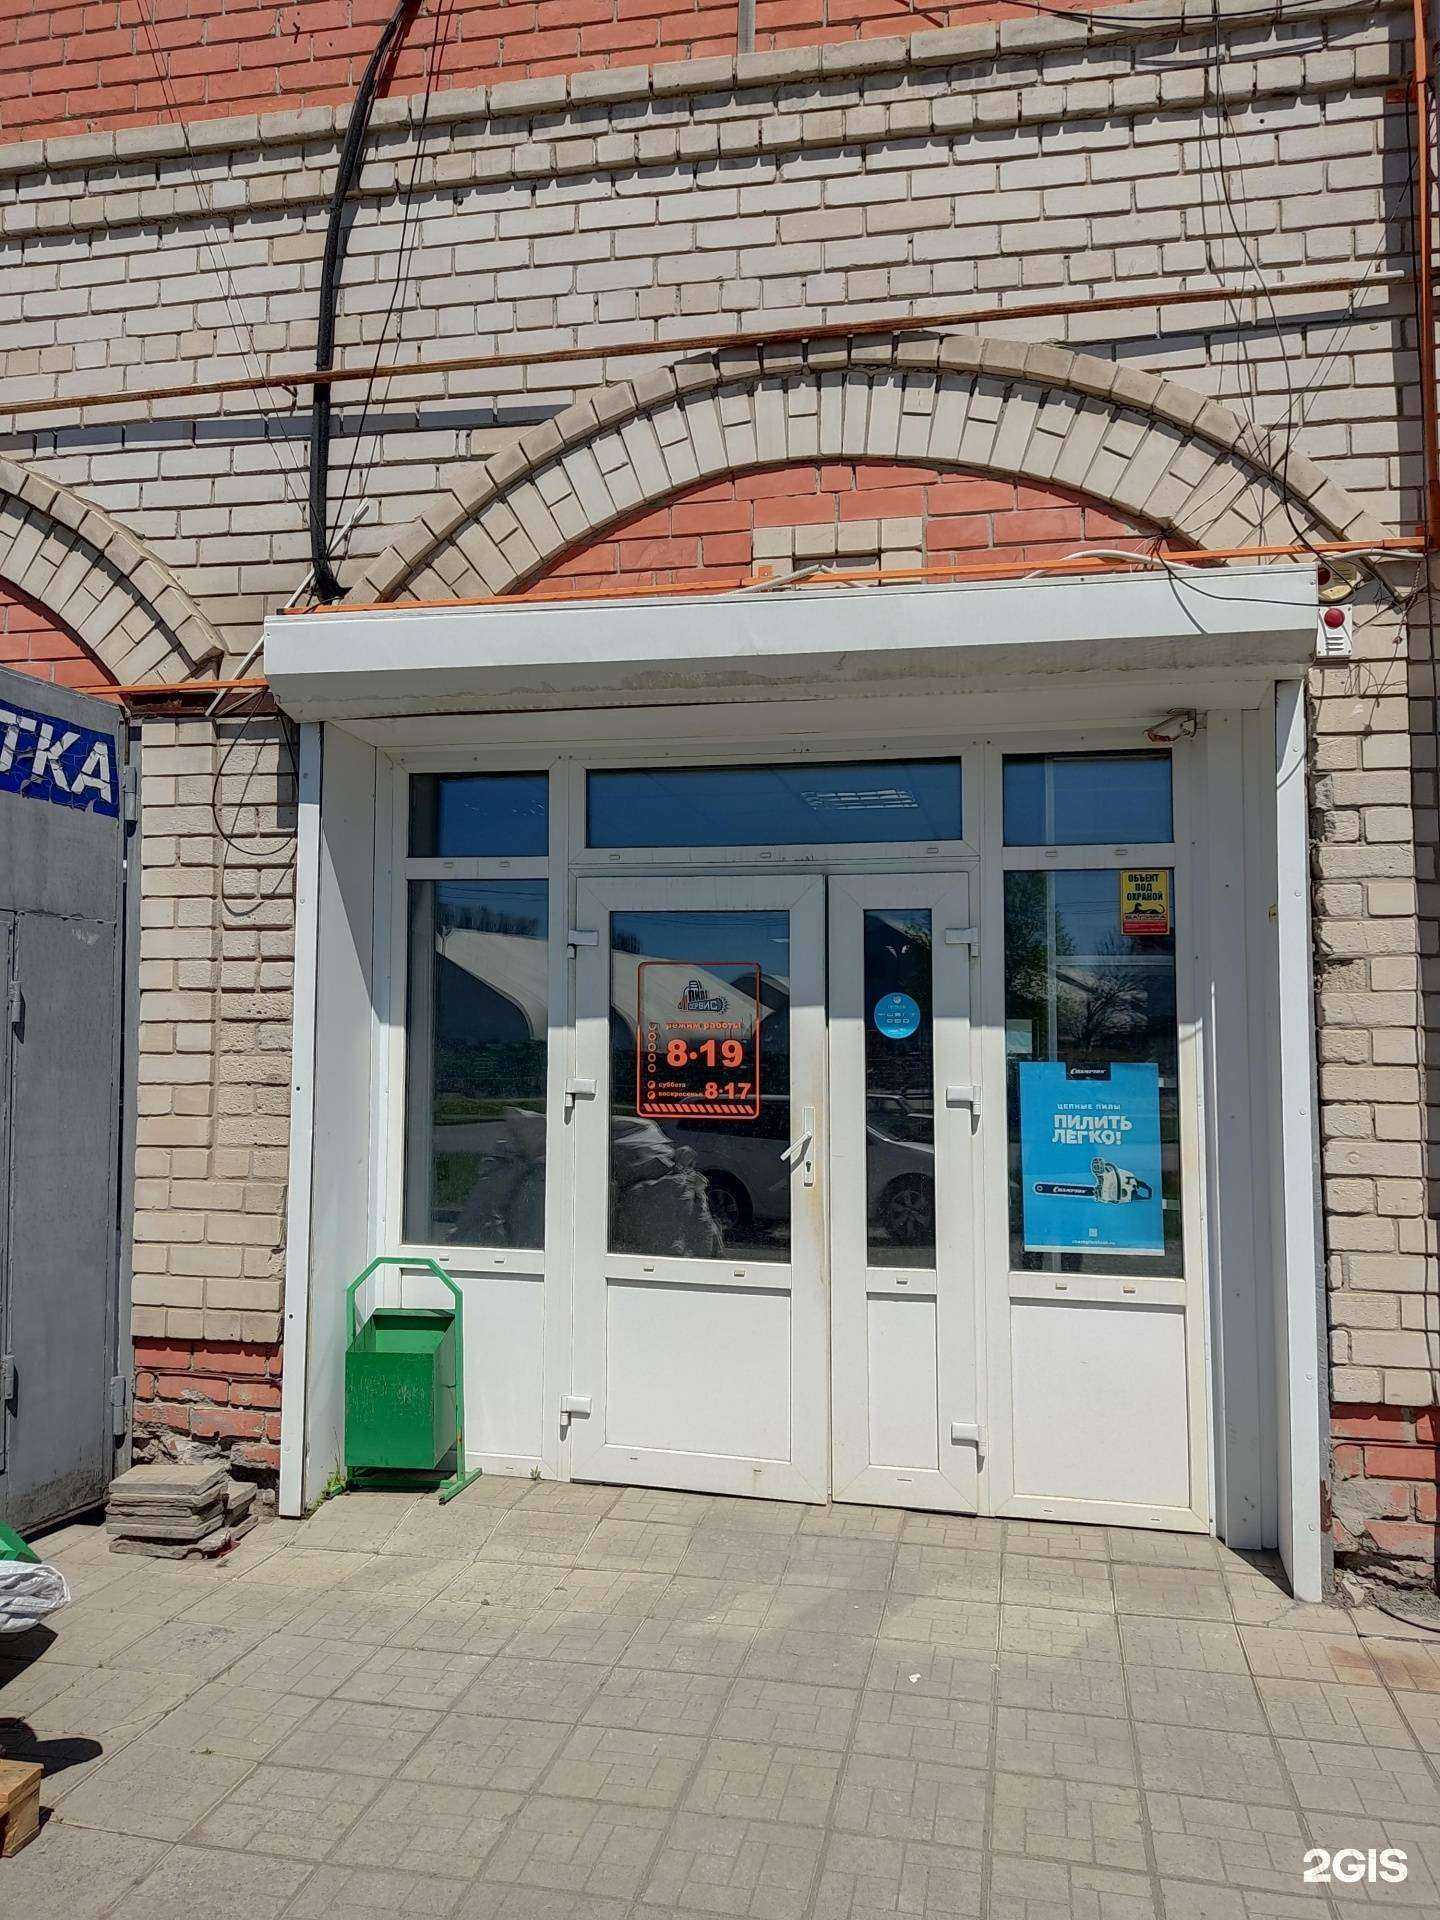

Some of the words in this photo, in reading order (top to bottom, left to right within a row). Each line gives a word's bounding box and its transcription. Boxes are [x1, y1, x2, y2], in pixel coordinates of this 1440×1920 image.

[0, 710, 112, 803] ТКА
[1128, 873, 1160, 882] ОБЪЕКТ
[1134, 883, 1153, 891] ПОД
[1126, 891, 1163, 901] ОХРАНОЙ
[665, 1022, 700, 1031] режим
[703, 1022, 742, 1031] работы
[658, 1081, 687, 1089] суббота
[1054, 1114, 1133, 1131] ПИЛИТЬ
[1051, 1129, 1123, 1145] ЛЕГКО!
